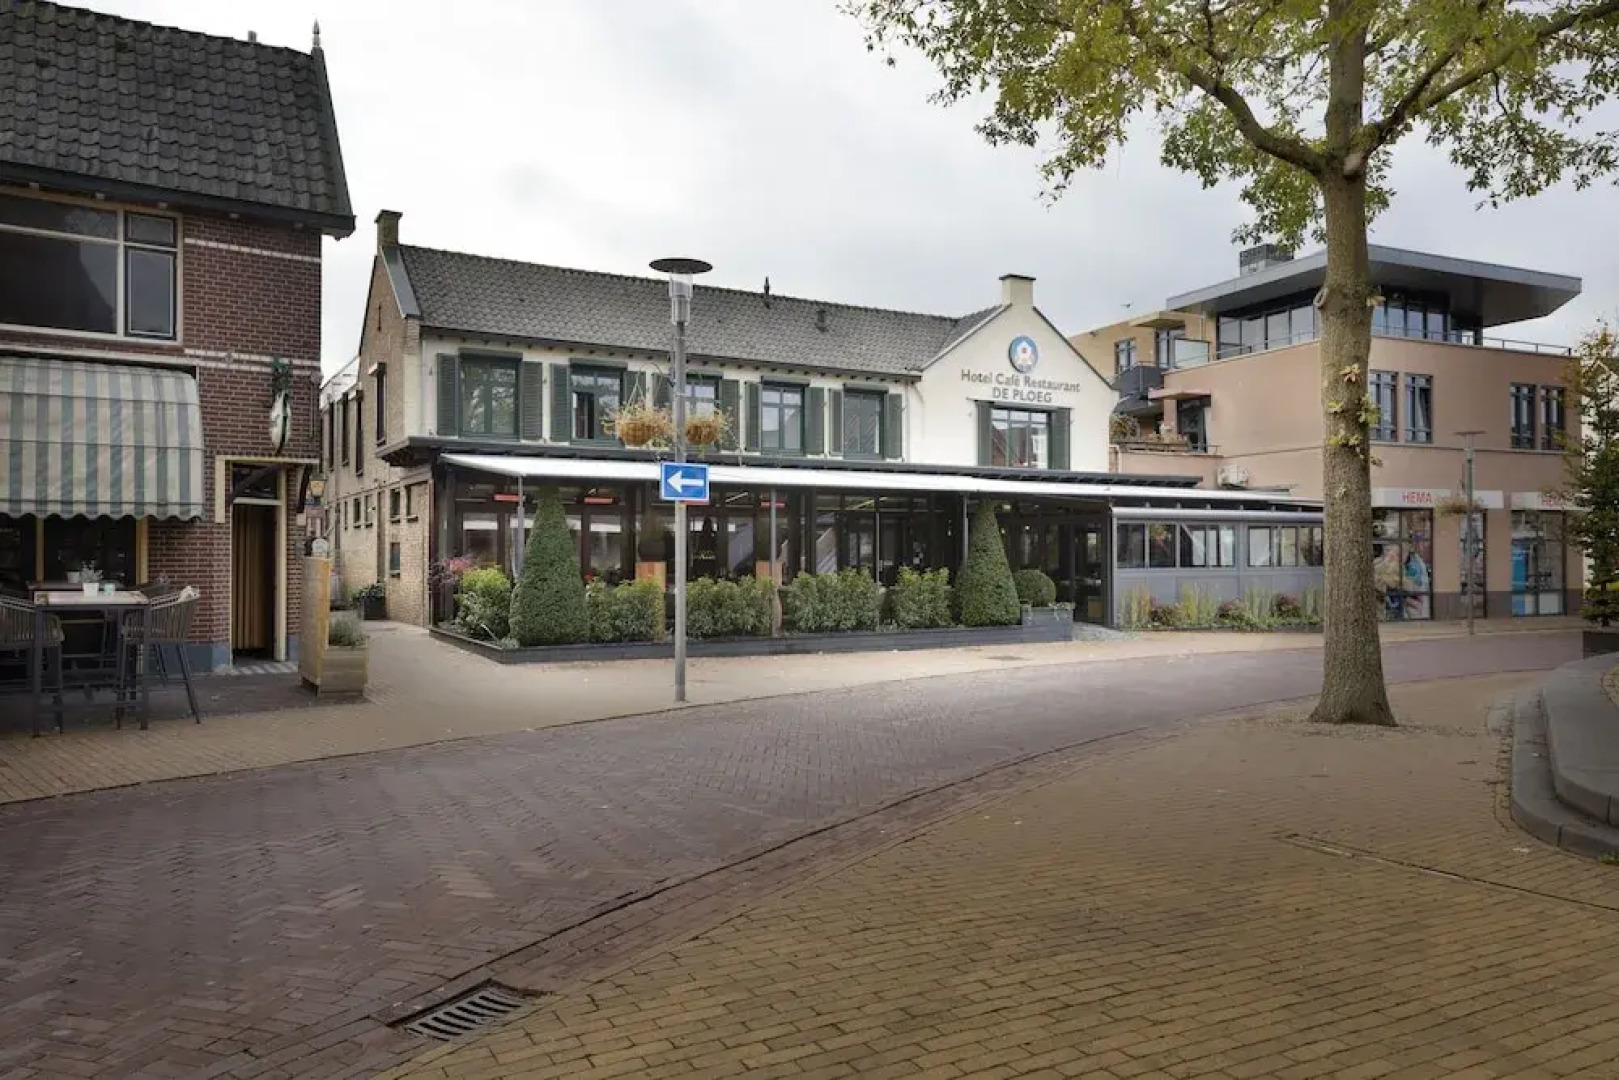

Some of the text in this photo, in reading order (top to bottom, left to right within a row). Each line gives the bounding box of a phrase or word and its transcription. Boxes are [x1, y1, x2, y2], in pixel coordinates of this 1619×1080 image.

[961, 369, 993, 383] Hotel
[1024, 376, 1080, 393] Restaurant
[992, 387, 1052, 403] DE PLOEG
[1402, 491, 1432, 503] HEMA
